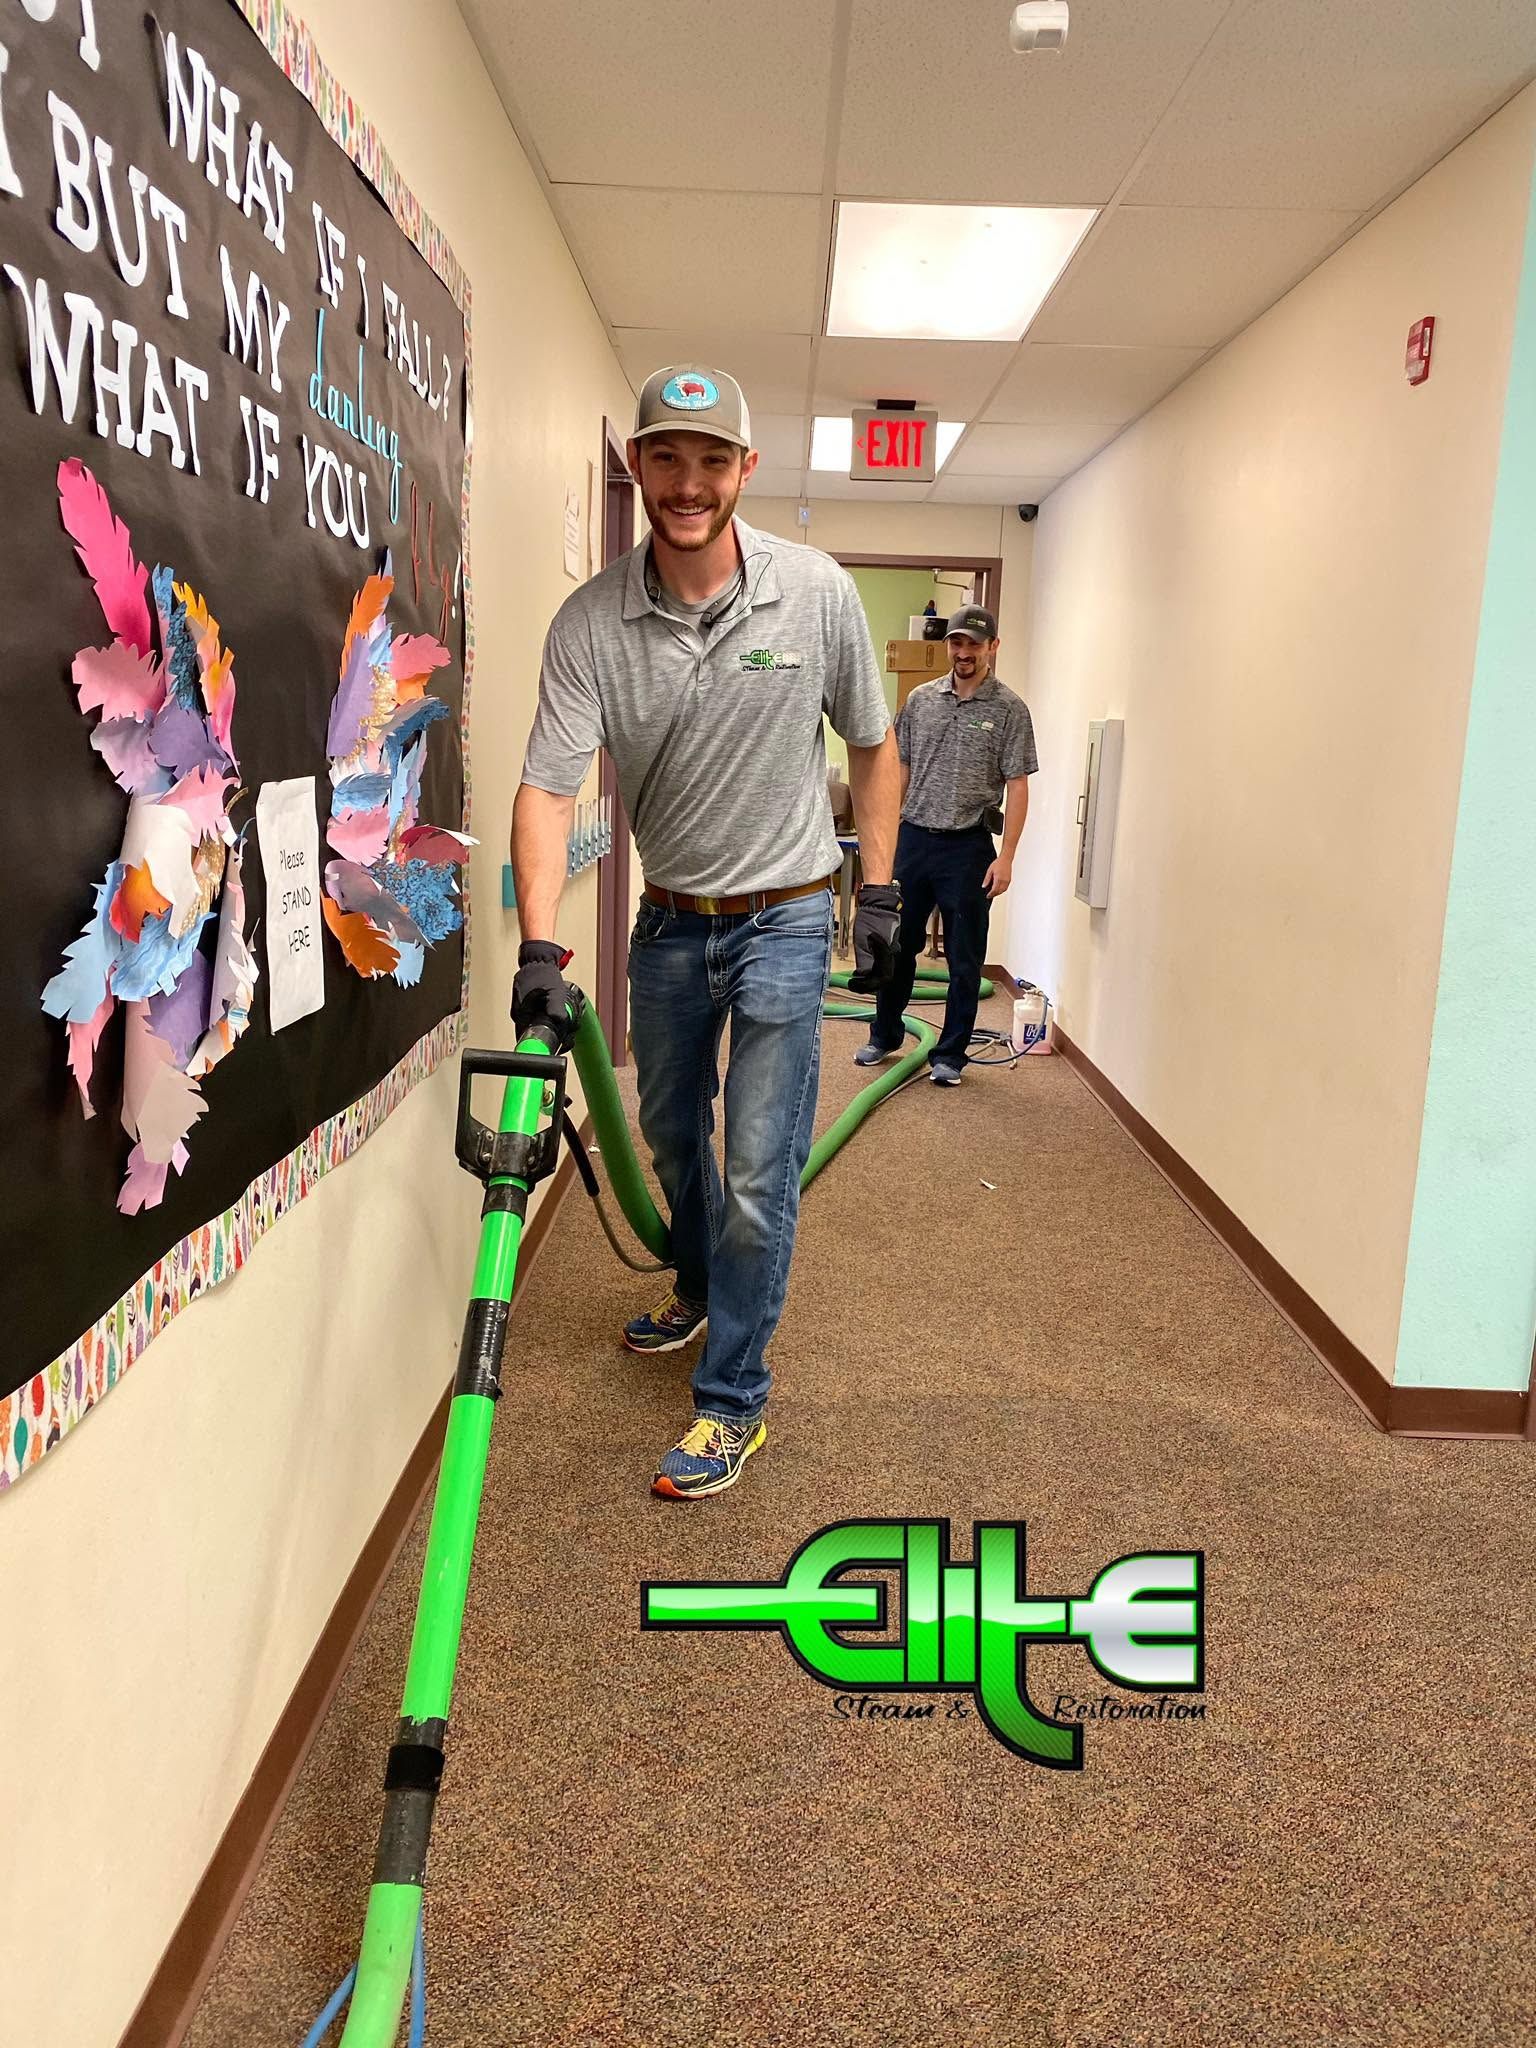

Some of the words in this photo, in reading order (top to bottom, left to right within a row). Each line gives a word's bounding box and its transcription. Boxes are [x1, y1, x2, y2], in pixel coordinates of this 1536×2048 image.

[152, 10, 293, 254] WHAT
[313, 201, 346, 309] IF
[357, 254, 370, 339] I
[382, 281, 451, 422] FALL?
[47, 90, 188, 320] BUT
[220, 244, 290, 393] MY
[309, 307, 403, 525] darling
[3, 263, 208, 476] WHAT
[240, 396, 281, 504] IF
[302, 434, 370, 549] YOU
[866, 419, 928, 468] EXIT
[280, 849, 304, 871] Please
[282, 885, 312, 915] STAND
[288, 925, 311, 955] HERE
